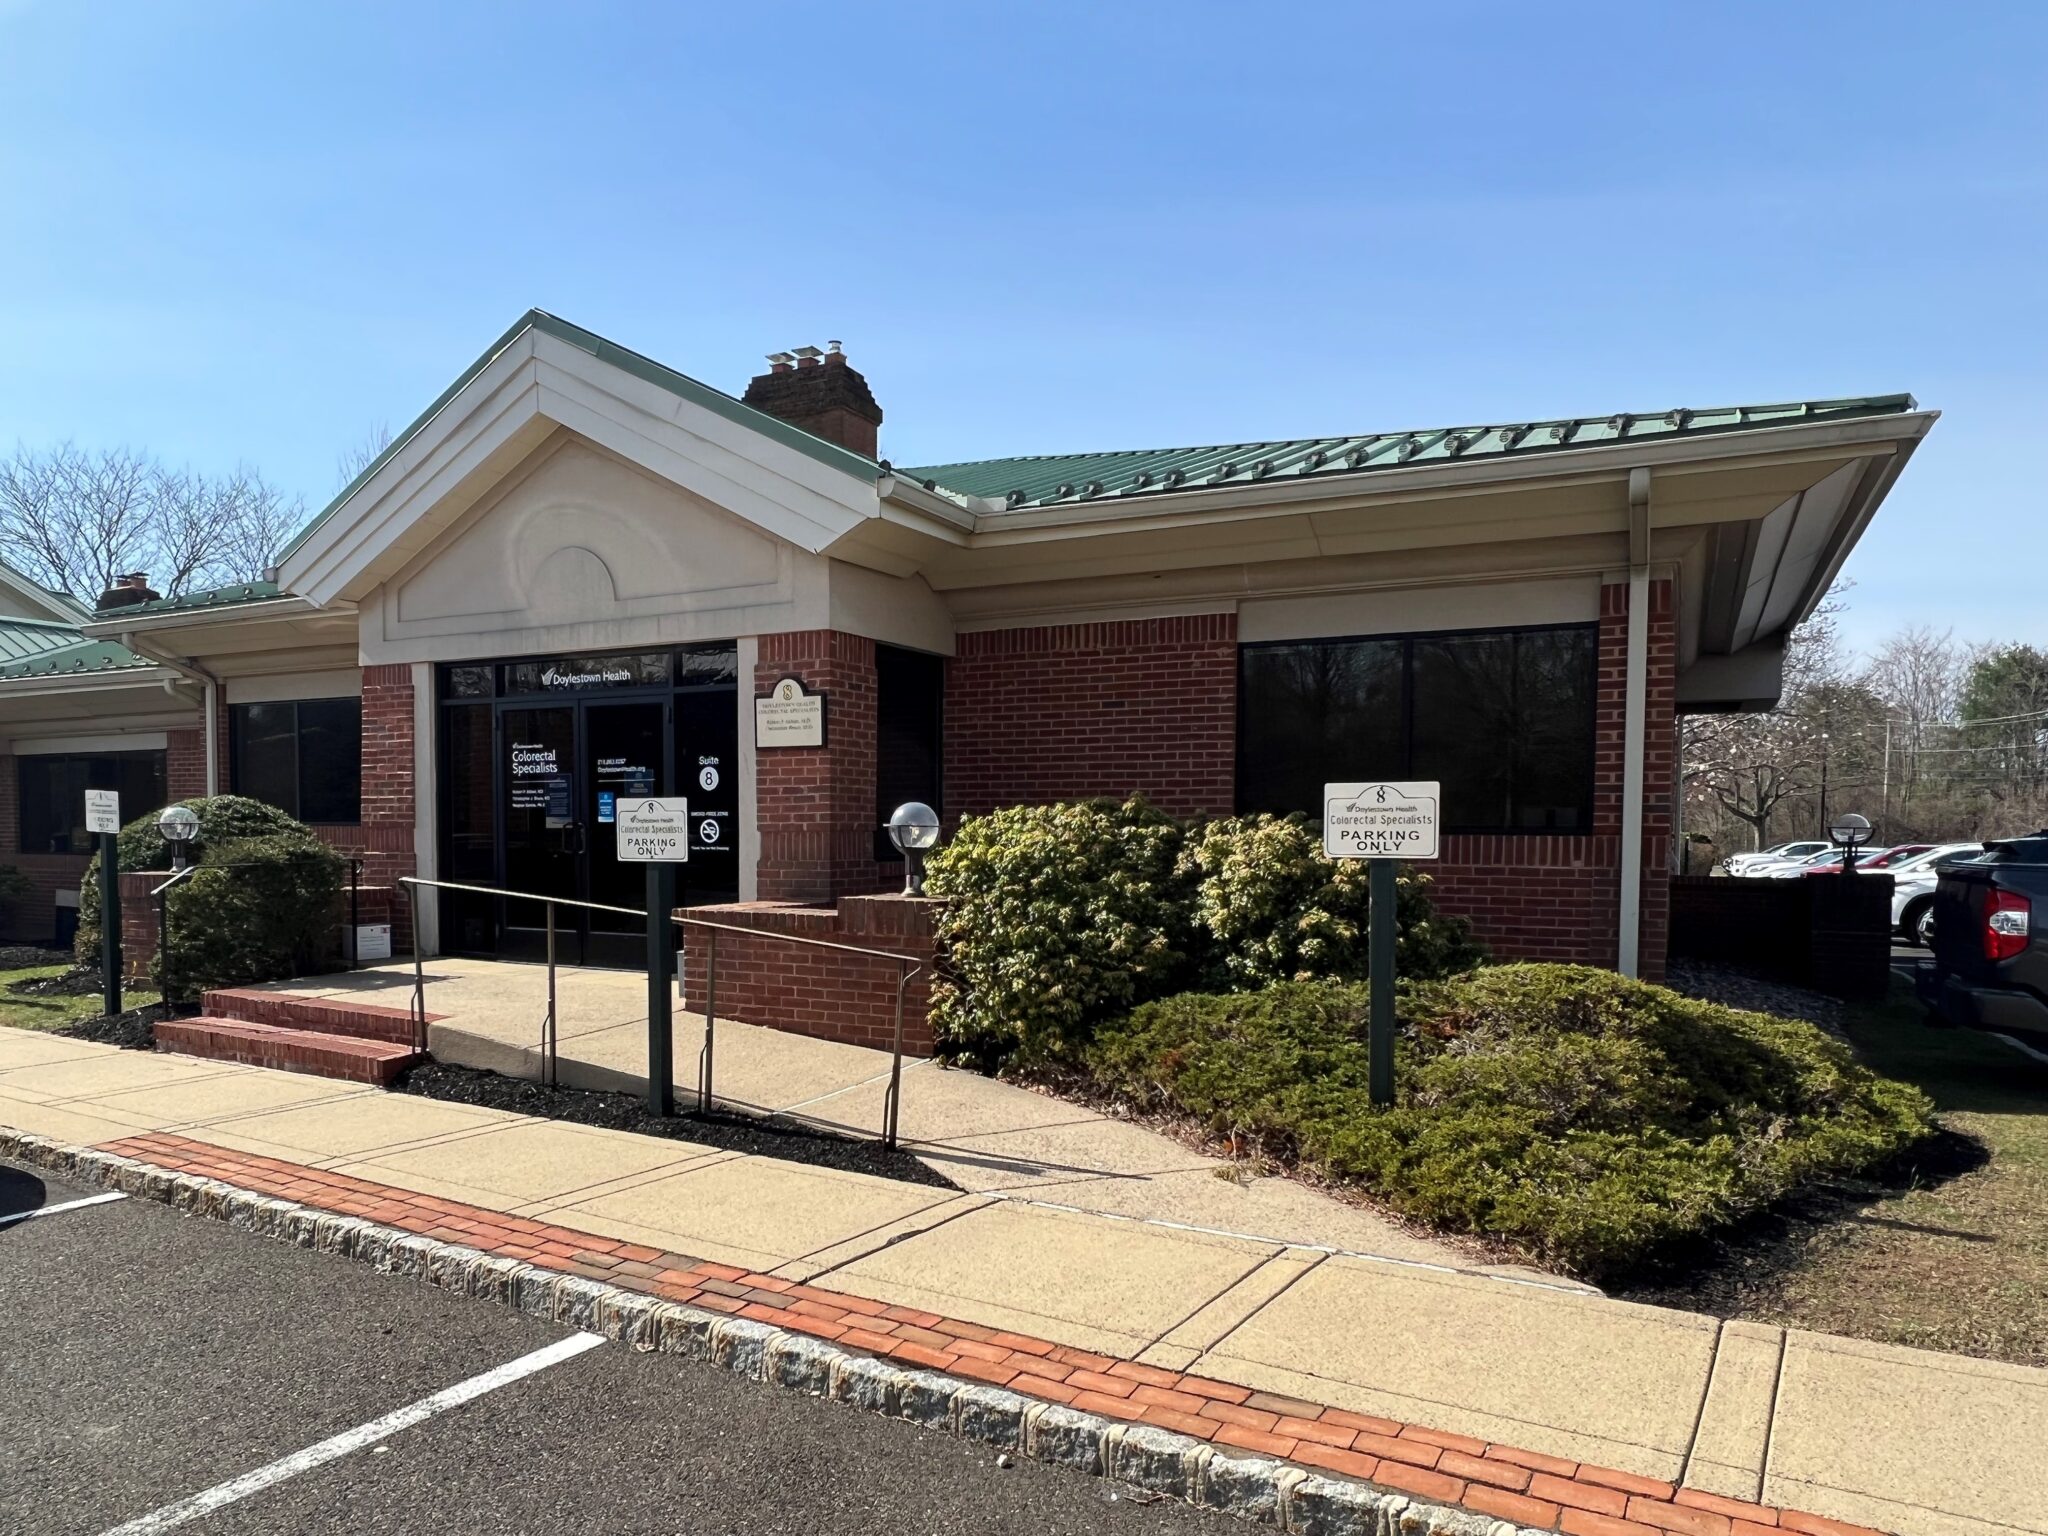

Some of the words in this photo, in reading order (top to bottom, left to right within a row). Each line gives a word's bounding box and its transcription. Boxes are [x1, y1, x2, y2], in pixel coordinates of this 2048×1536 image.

[553, 673, 600, 686] Doylestown
[603, 669, 631, 681] Health
[783, 685, 792, 700] 8
[512, 749, 556, 762] Colorectal
[698, 755, 720, 765] Suite
[512, 762, 558, 777] Specialists
[705, 772, 713, 785] 8
[1376, 789, 1386, 803] 8
[648, 803, 654, 814] 8
[1355, 806, 1394, 814] Doylestown
[1330, 815, 1377, 825] Colorectal
[1380, 815, 1433, 826] Specialists
[621, 826, 650, 834] Colorectal
[651, 825, 684, 836] Specialists
[1340, 830, 1420, 840] PARKING
[627, 838, 676, 847] PARKING
[1356, 841, 1402, 851] ONLY
[637, 847, 666, 855] ONLY
